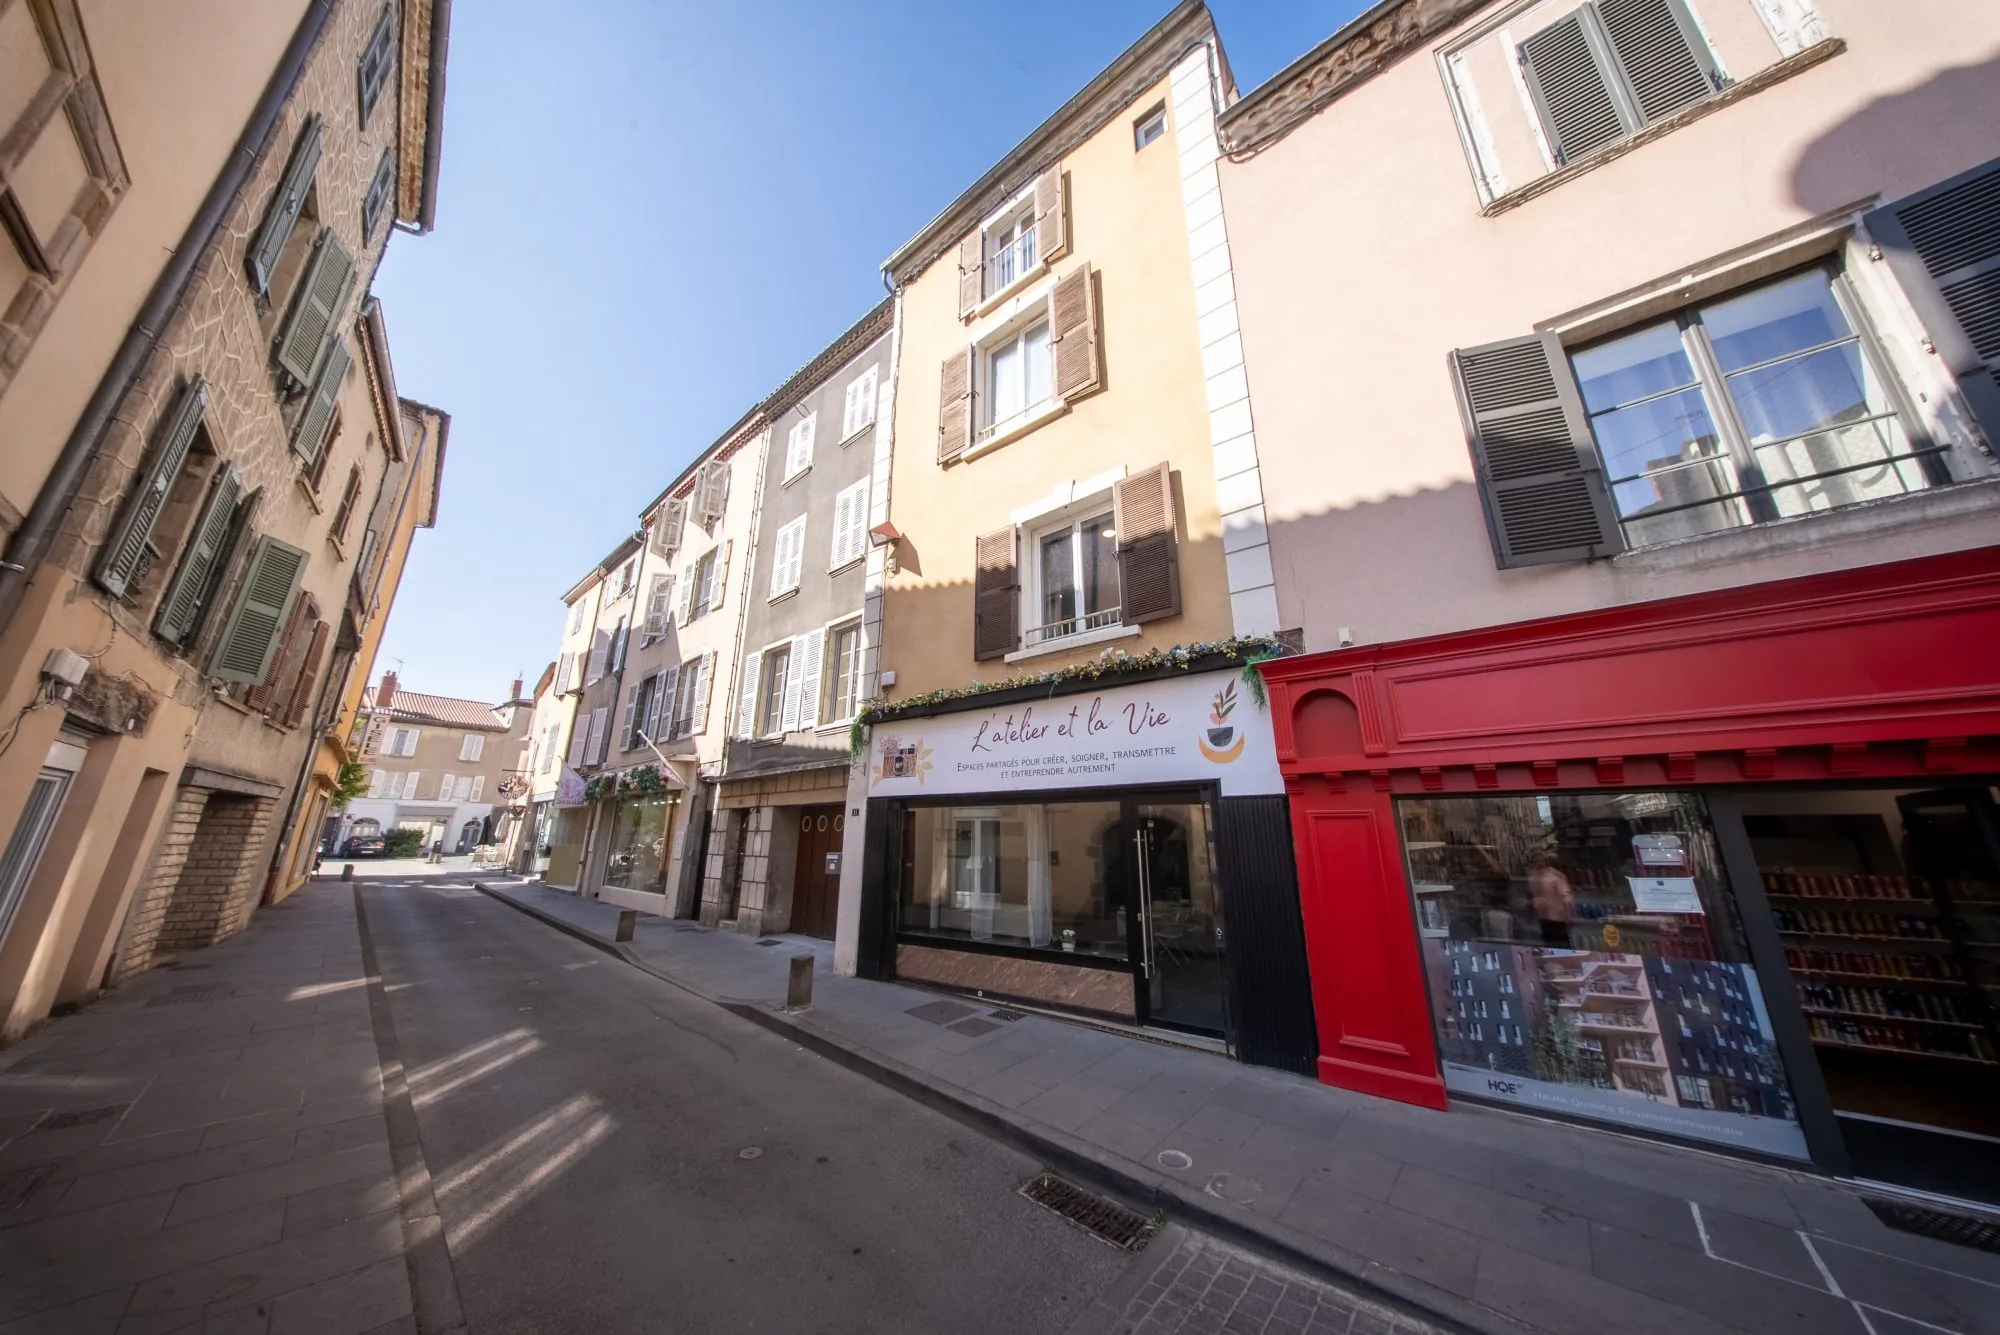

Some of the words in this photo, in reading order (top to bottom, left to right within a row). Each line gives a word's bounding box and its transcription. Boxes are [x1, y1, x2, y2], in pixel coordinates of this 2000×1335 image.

[972, 706, 1050, 753] L'atelier
[1058, 704, 1079, 738] et
[1088, 697, 1113, 736] la
[1122, 701, 1172, 735] Vie
[986, 758, 1019, 769] PARTAGÉS
[1021, 757, 1040, 767] POUR
[1042, 754, 1068, 765] CRÉER,
[1071, 752, 1109, 764] SOIGNER,
[1112, 746, 1177, 760] TRANSMETTRE
[1000, 771, 1009, 779] ET
[1011, 767, 1065, 778] ENTREPRENDRE
[1067, 763, 1117, 775] AUTREMENT
[1532, 1090, 1571, 1104] Haute
